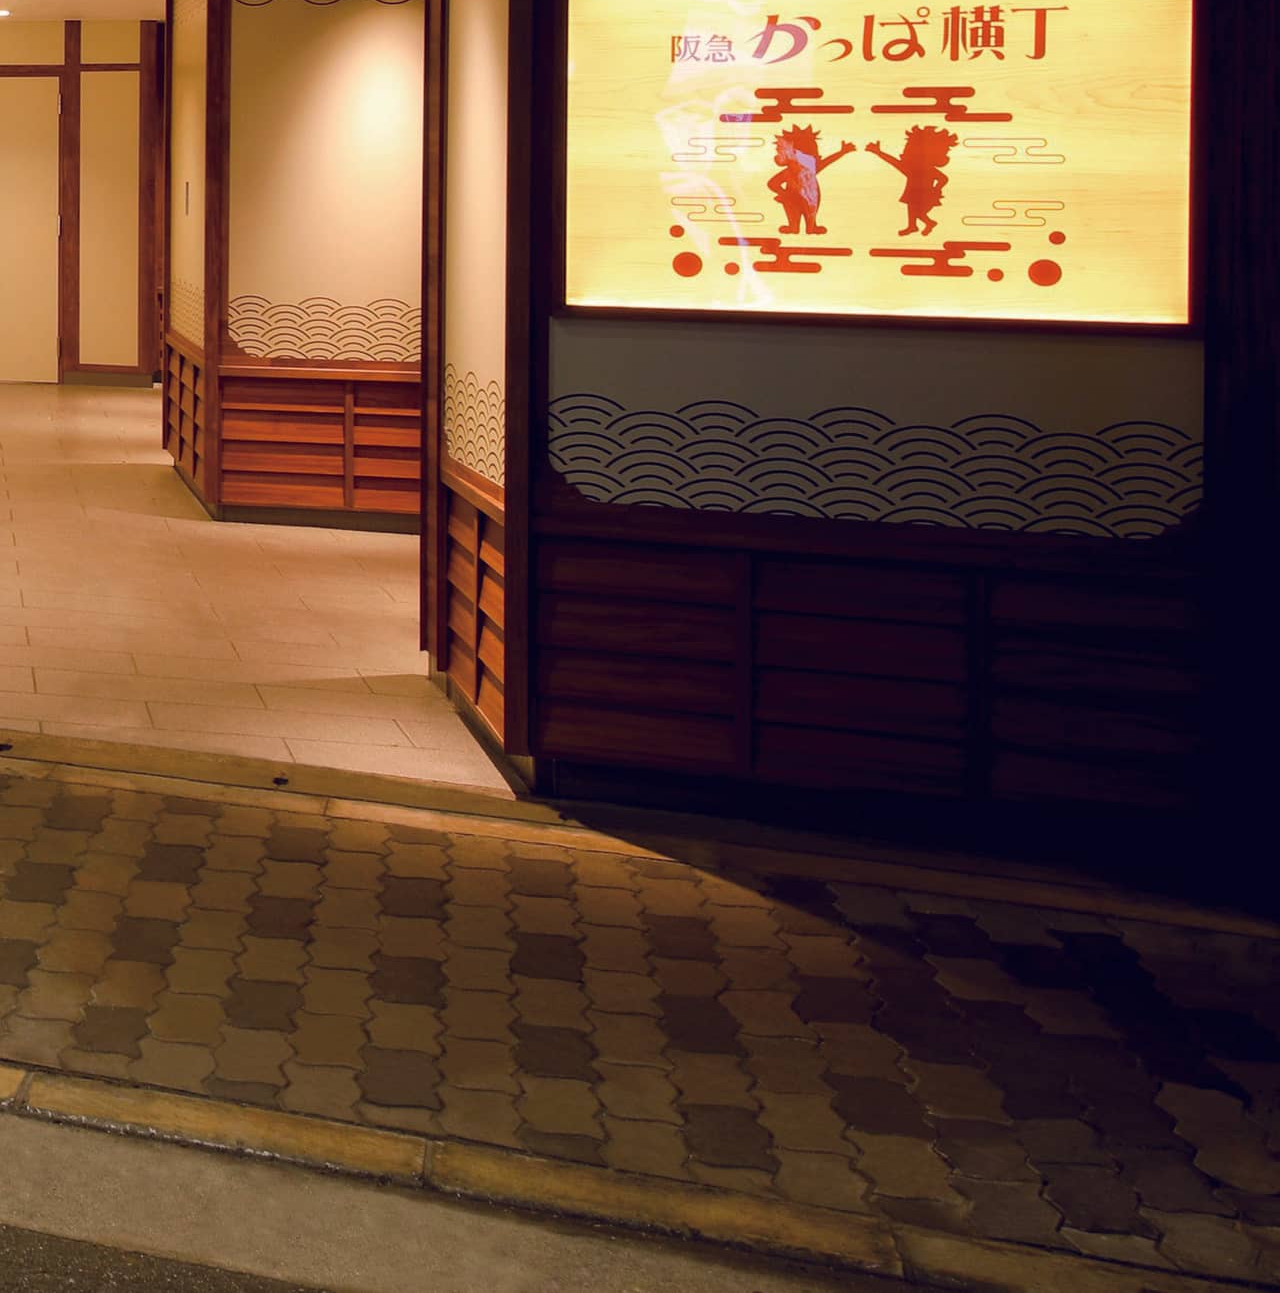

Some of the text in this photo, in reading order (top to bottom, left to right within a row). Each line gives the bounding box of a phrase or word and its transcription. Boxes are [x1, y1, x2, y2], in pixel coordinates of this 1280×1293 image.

[670, 5, 1070, 65] 阪急 かっぱ横丁
